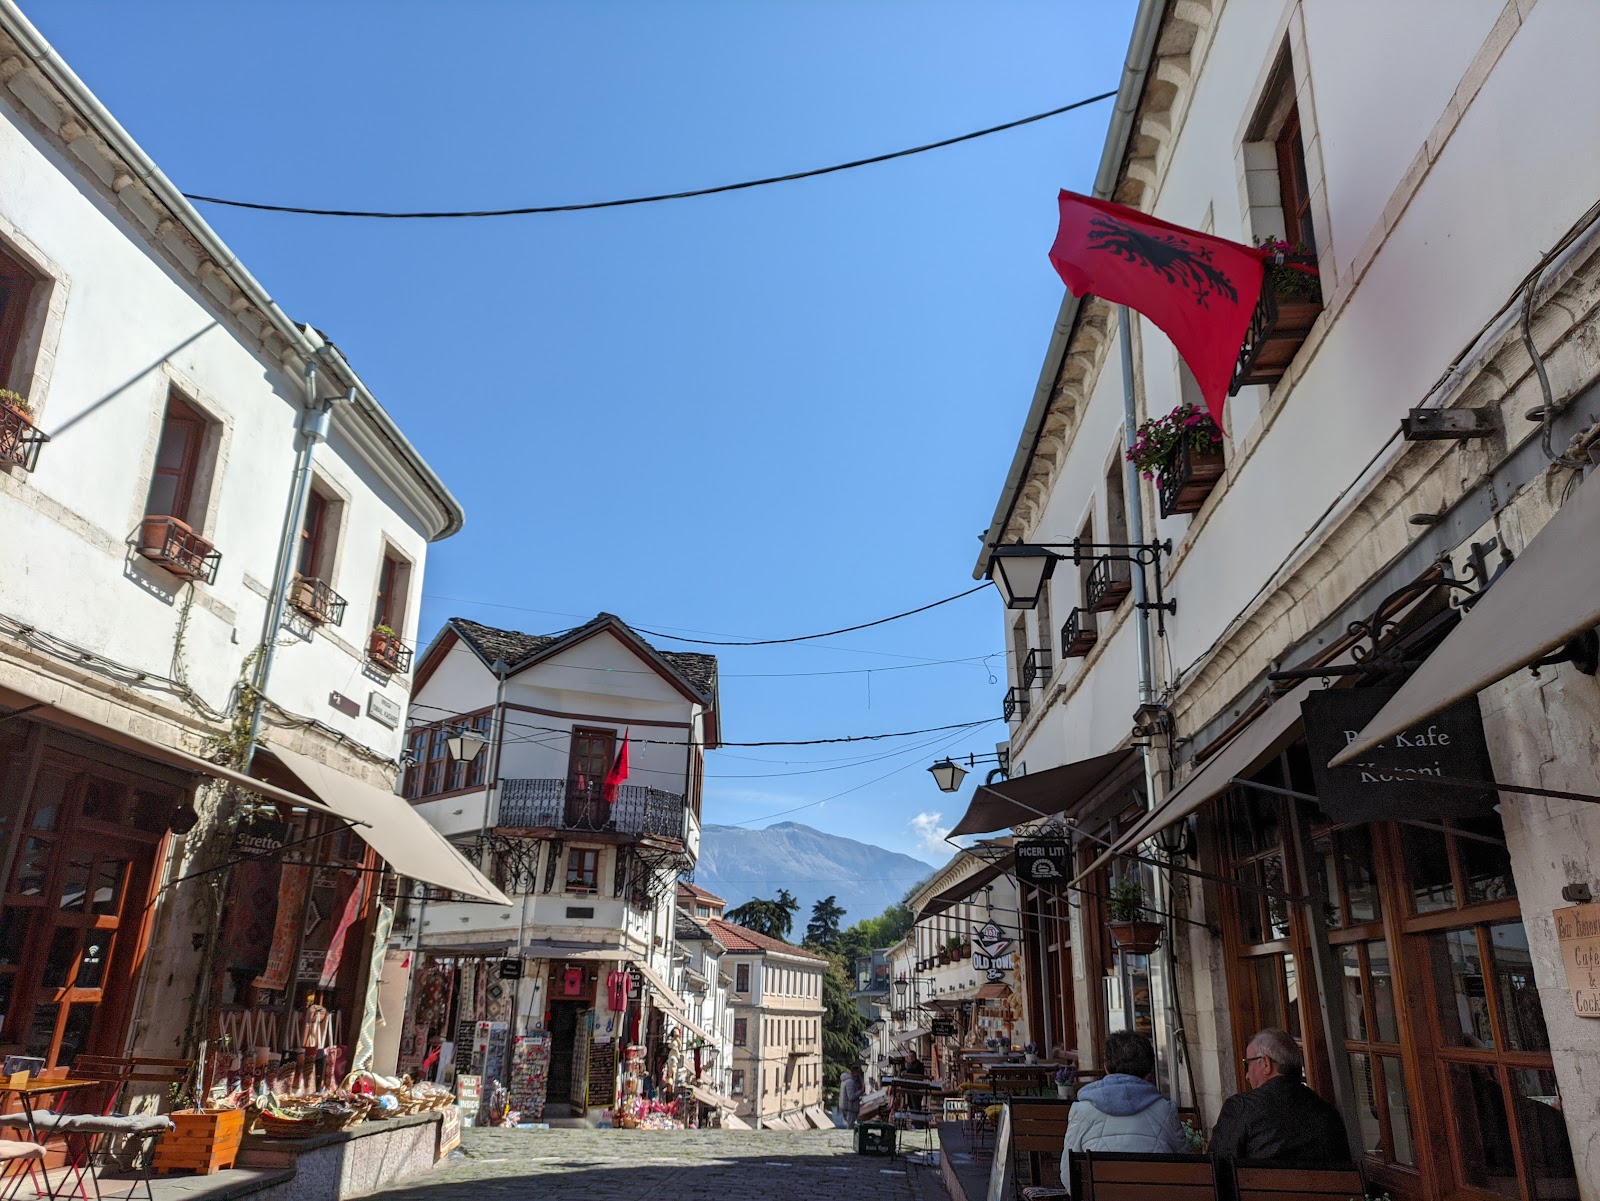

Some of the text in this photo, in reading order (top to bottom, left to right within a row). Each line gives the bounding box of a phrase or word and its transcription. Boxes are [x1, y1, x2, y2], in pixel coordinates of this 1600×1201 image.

[1395, 725, 1451, 748] Kafe
[236, 832, 283, 850] Stretto
[1018, 846, 1066, 857] PICERI LITI
[973, 952, 990, 970] OLD
[1576, 990, 1600, 1013] Cock
